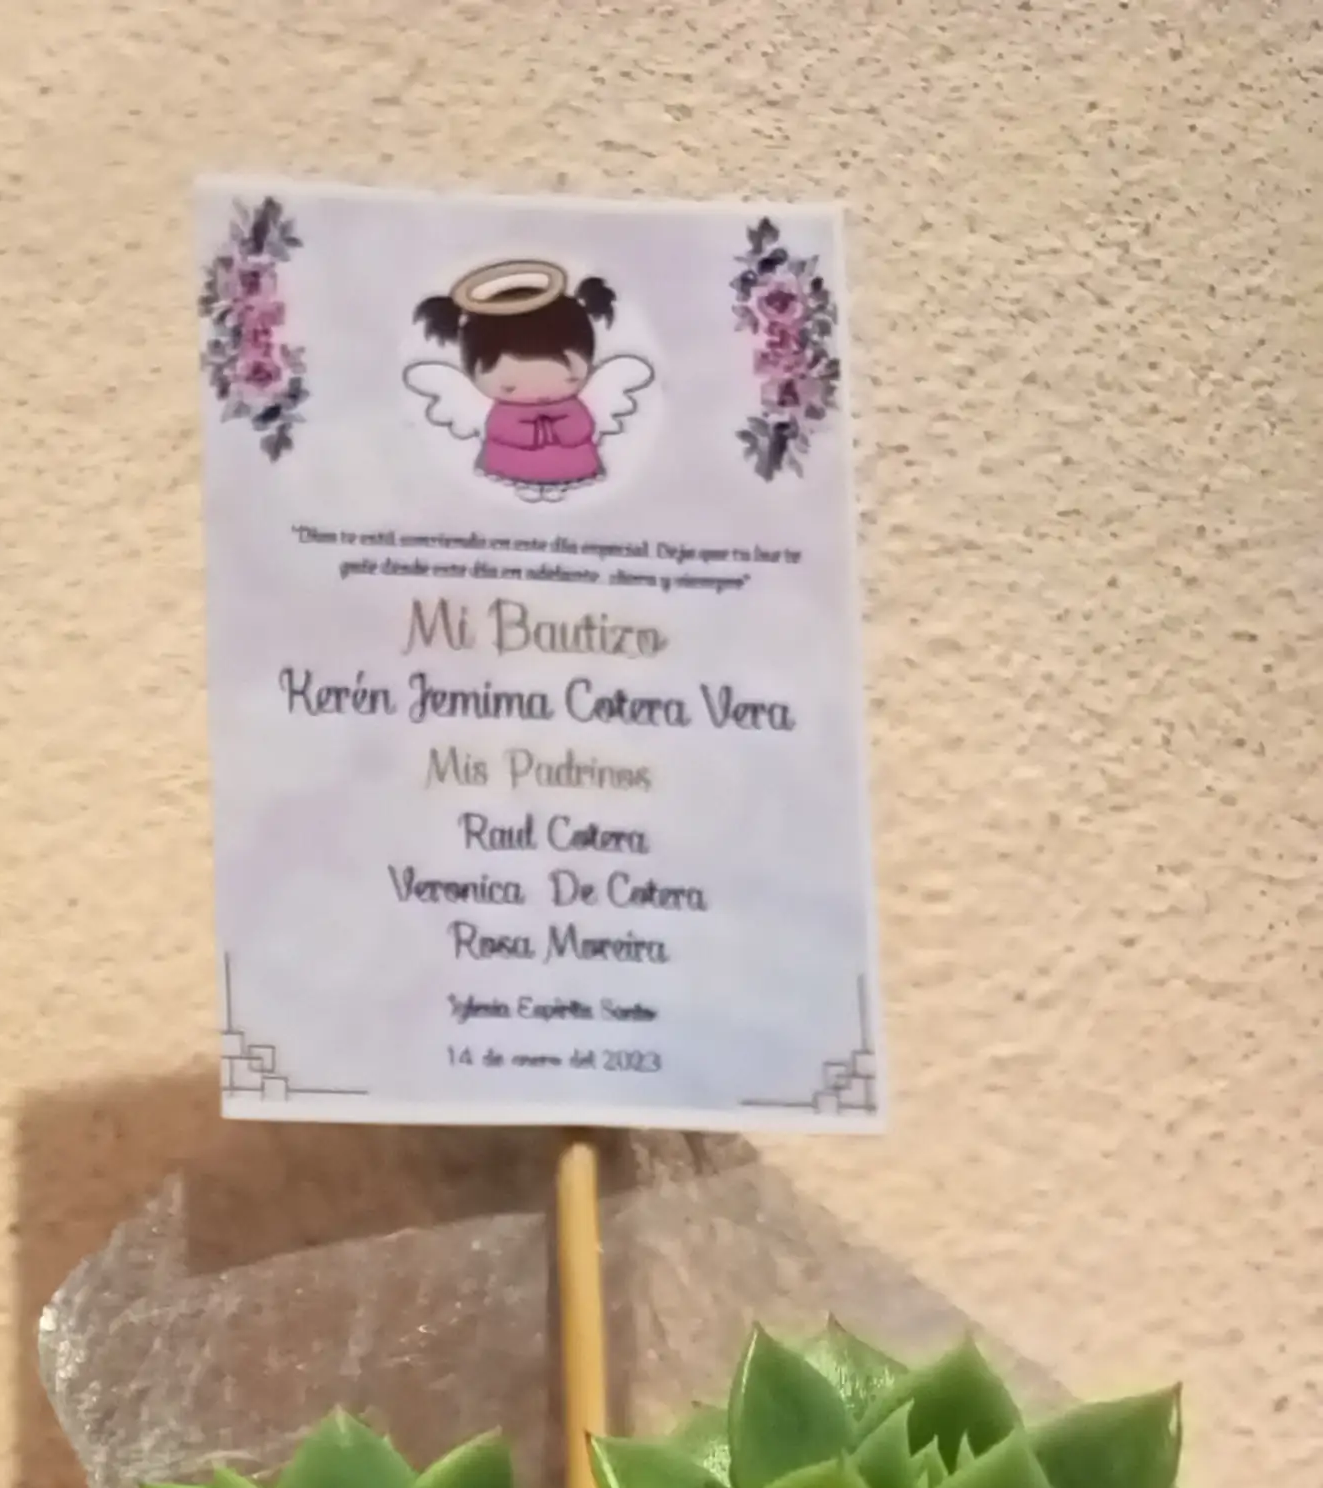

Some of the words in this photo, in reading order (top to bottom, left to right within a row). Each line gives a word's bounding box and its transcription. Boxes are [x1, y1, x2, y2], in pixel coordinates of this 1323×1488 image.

[400, 598, 474, 656] Mi
[489, 598, 667, 657] Bautizo
[278, 668, 396, 715] Kerén
[408, 673, 554, 723] Jemima
[565, 678, 691, 727] Cotera
[699, 683, 795, 731] Vera
[424, 747, 489, 790] Mis
[507, 750, 652, 792] Padrinos
[458, 812, 537, 851] Raul
[547, 815, 650, 854] Cotera
[387, 864, 525, 905] Veronica
[548, 870, 597, 906] De
[607, 871, 707, 912] Cotera
[447, 921, 535, 961] Rosa
[542, 924, 669, 966] Moreira
[447, 1045, 474, 1065] 14
[481, 1047, 503, 1066] de
[569, 1048, 596, 1069] del
[602, 1048, 662, 1072] 2023
